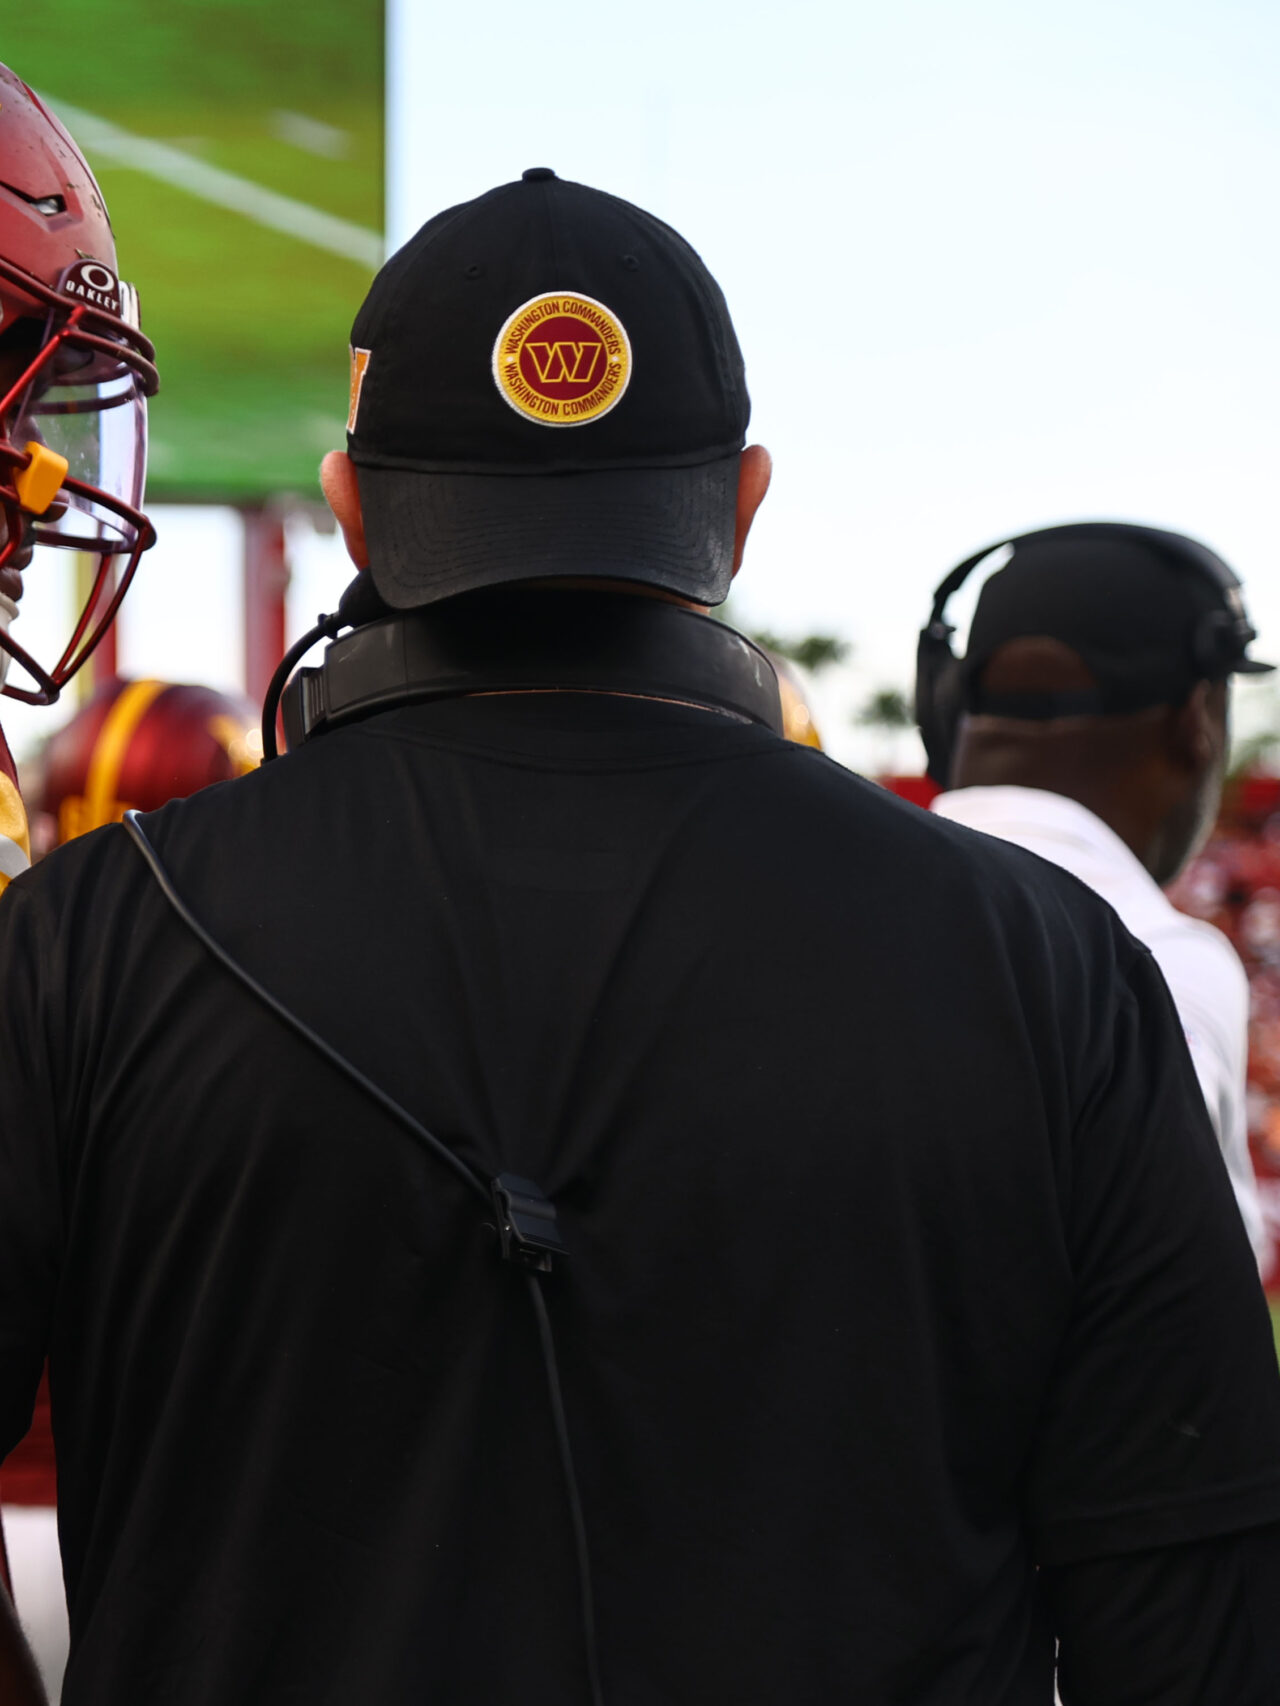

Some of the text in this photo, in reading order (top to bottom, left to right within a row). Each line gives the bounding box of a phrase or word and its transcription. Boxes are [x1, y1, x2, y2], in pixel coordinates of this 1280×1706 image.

[66, 280, 118, 311] OAKLEY
[505, 300, 621, 356] WASHINGTON COMMANDERS
[525, 342, 602, 383] W
[504, 362, 621, 416] WASHINGTON COMMANDERS
